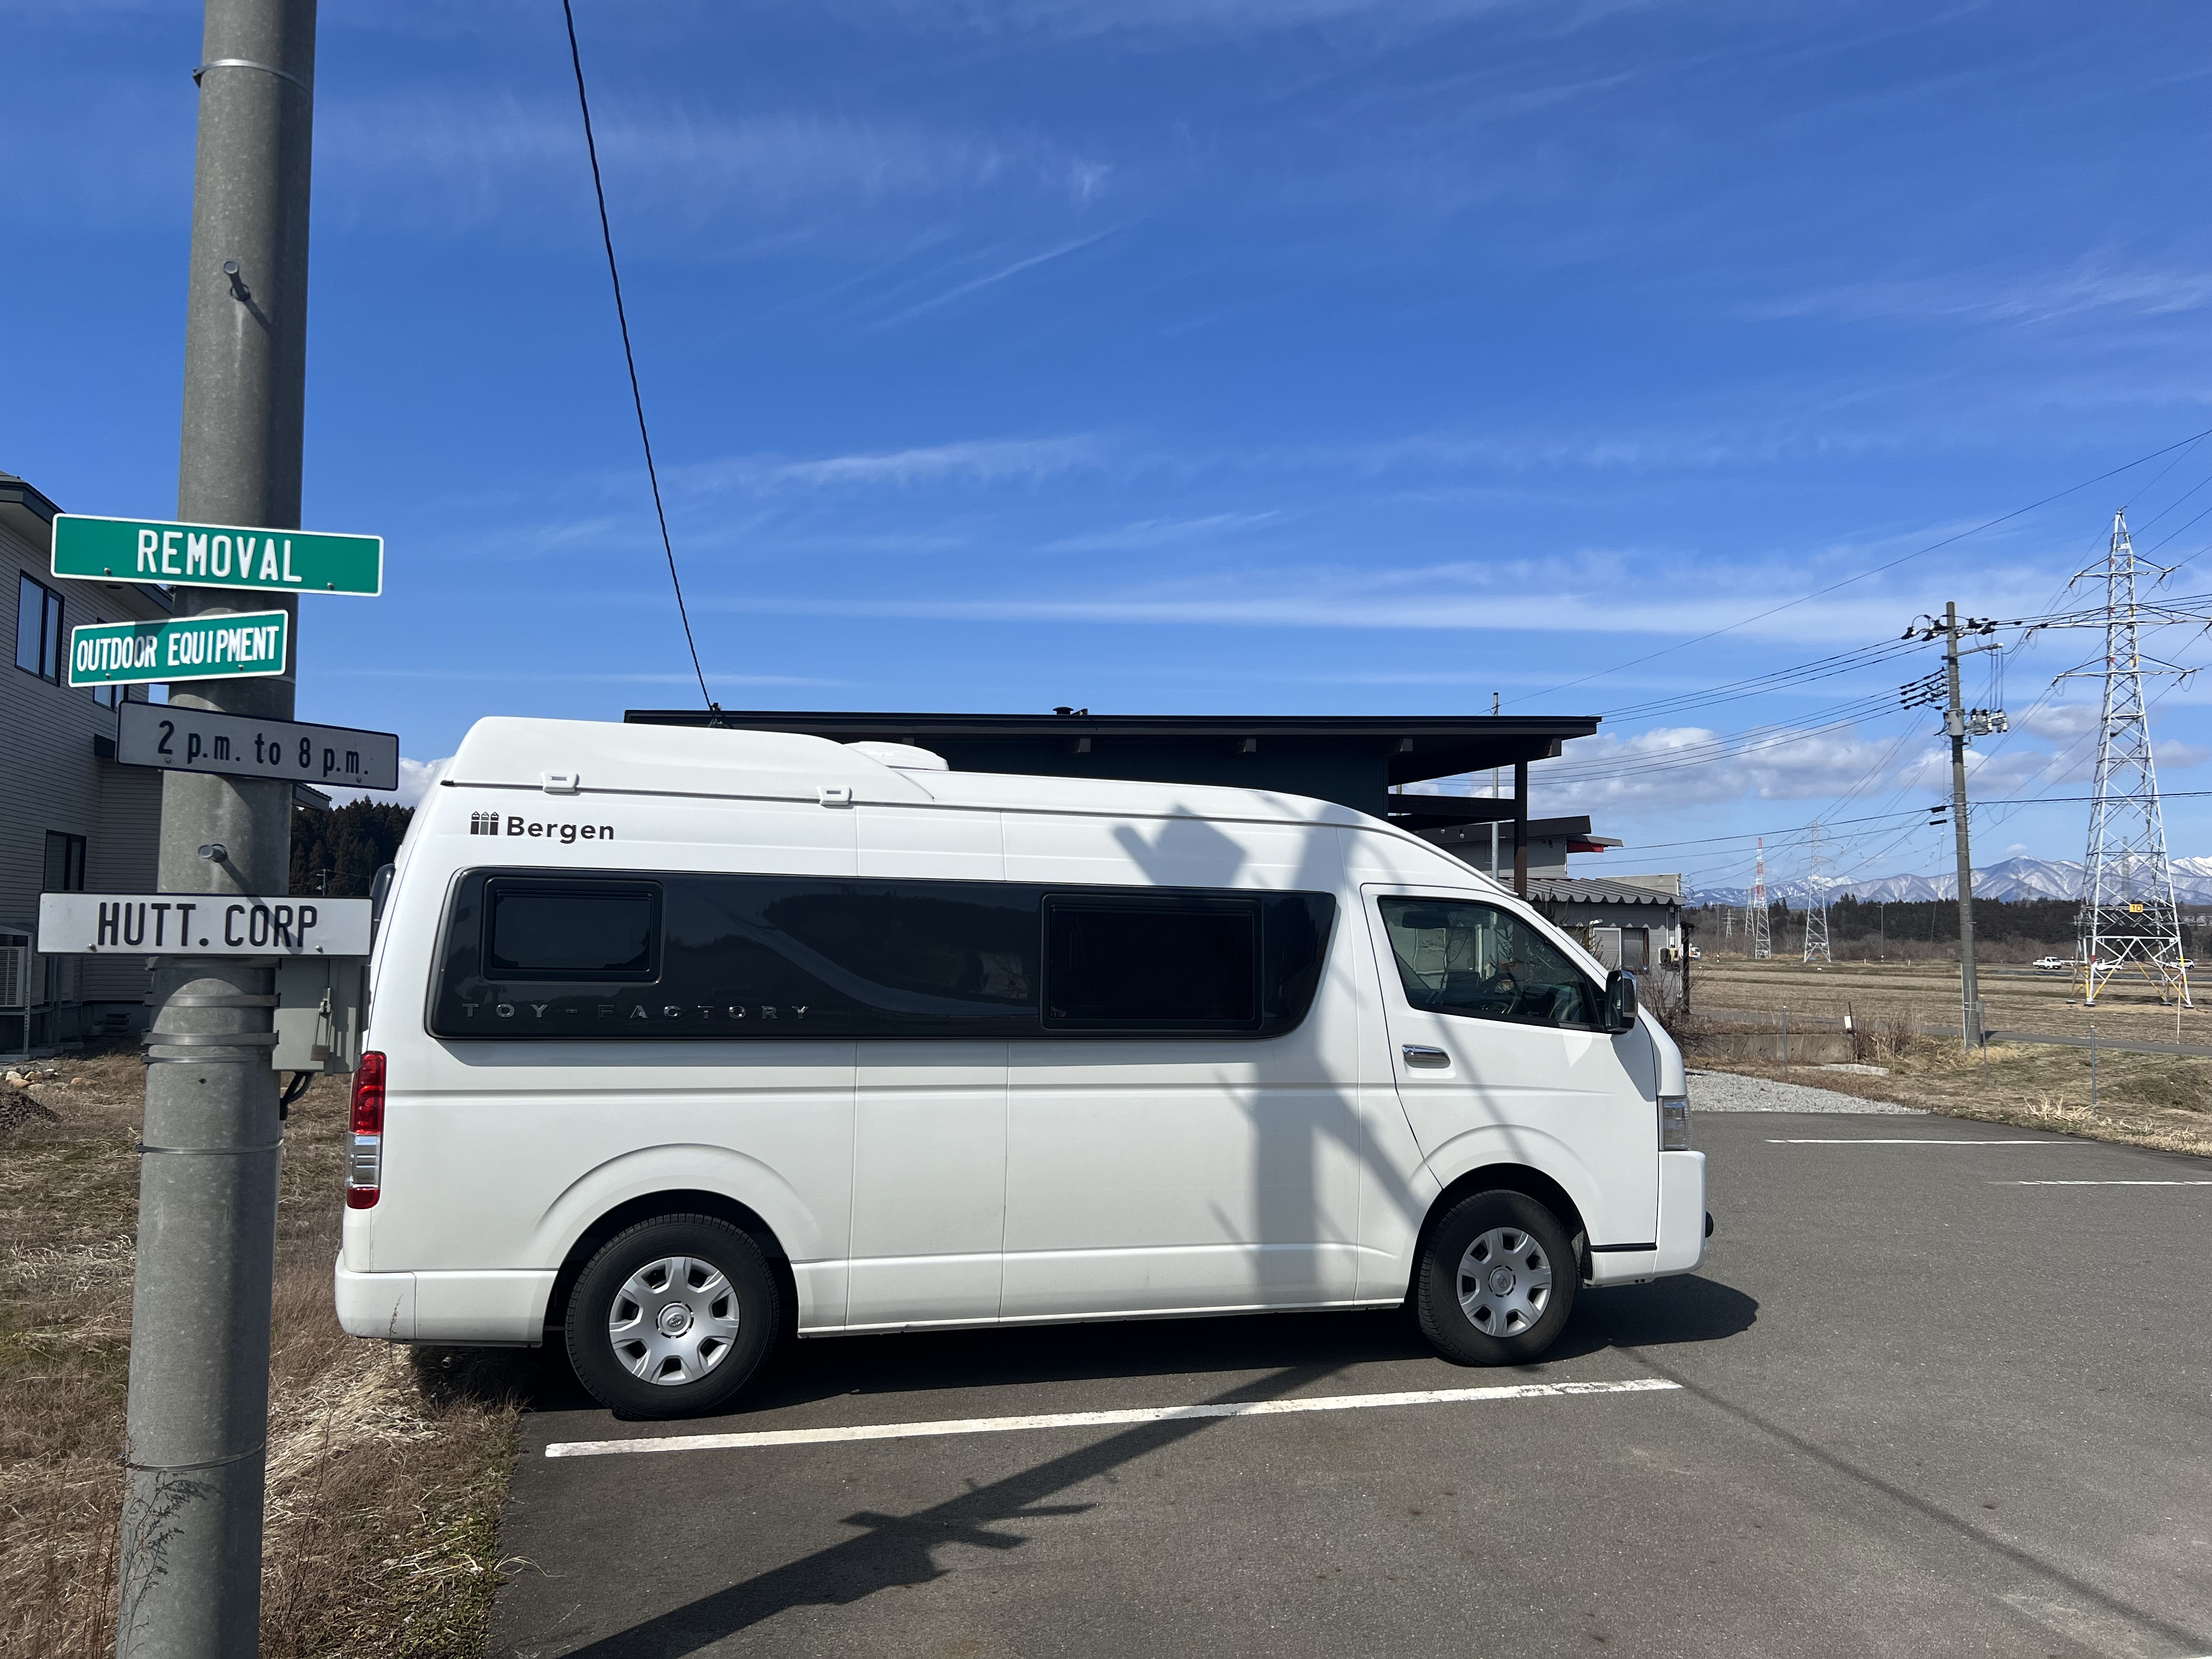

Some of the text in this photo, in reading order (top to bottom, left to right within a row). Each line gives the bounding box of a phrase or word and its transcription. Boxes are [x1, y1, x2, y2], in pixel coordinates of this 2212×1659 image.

[137, 529, 302, 583] REMOVAL
[76, 625, 279, 672] OUTDOOR EQUIPMENT
[158, 720, 369, 778] 2 p.m. to 8 p.m.
[506, 815, 614, 844] Bergen
[97, 901, 318, 948] HUTT. CORP
